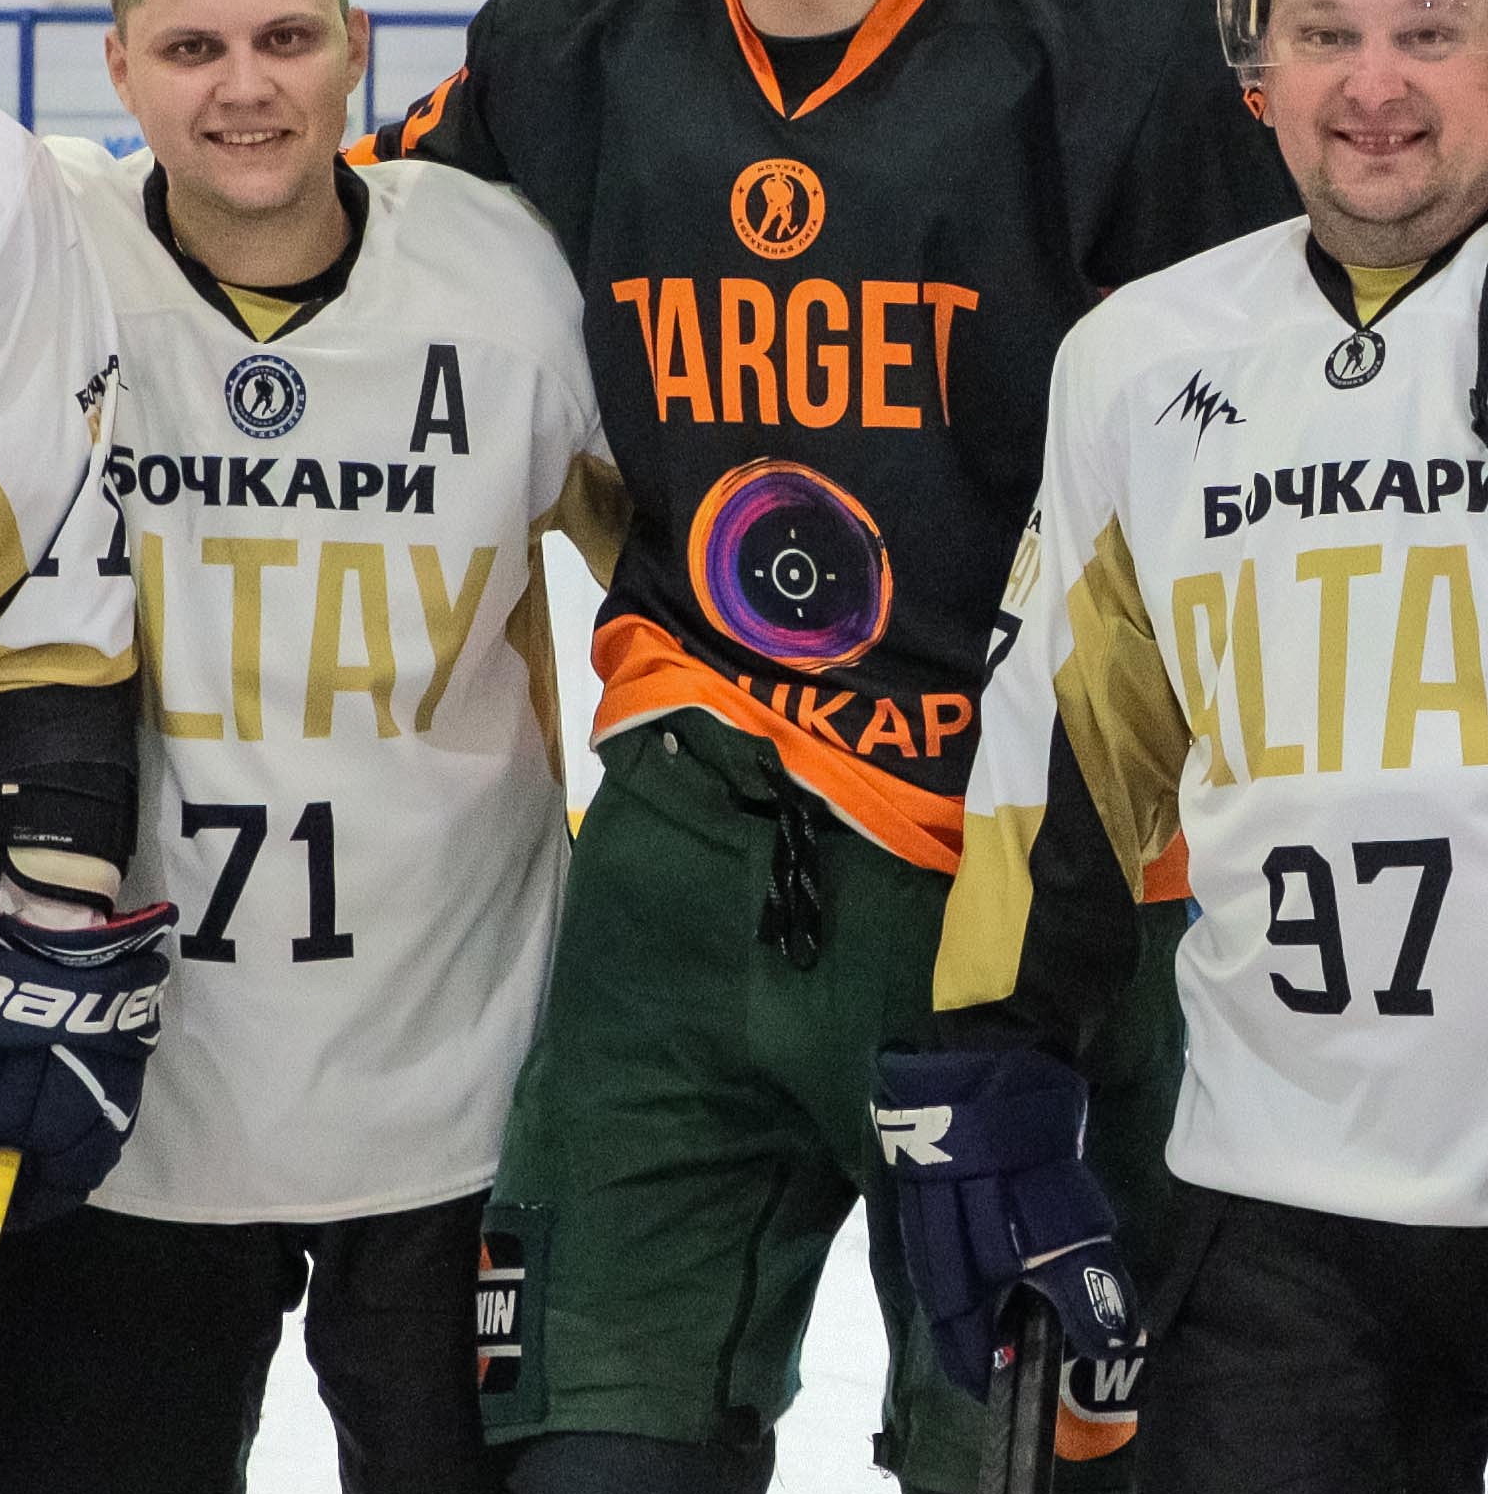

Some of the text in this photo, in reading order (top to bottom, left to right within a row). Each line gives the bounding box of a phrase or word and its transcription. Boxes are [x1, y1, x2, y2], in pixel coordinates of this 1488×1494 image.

[612, 277, 980, 429] TARGET
[103, 445, 436, 515] БОЧКАРИ
[180, 801, 355, 964] 71
[1262, 837, 1454, 1019] 97
